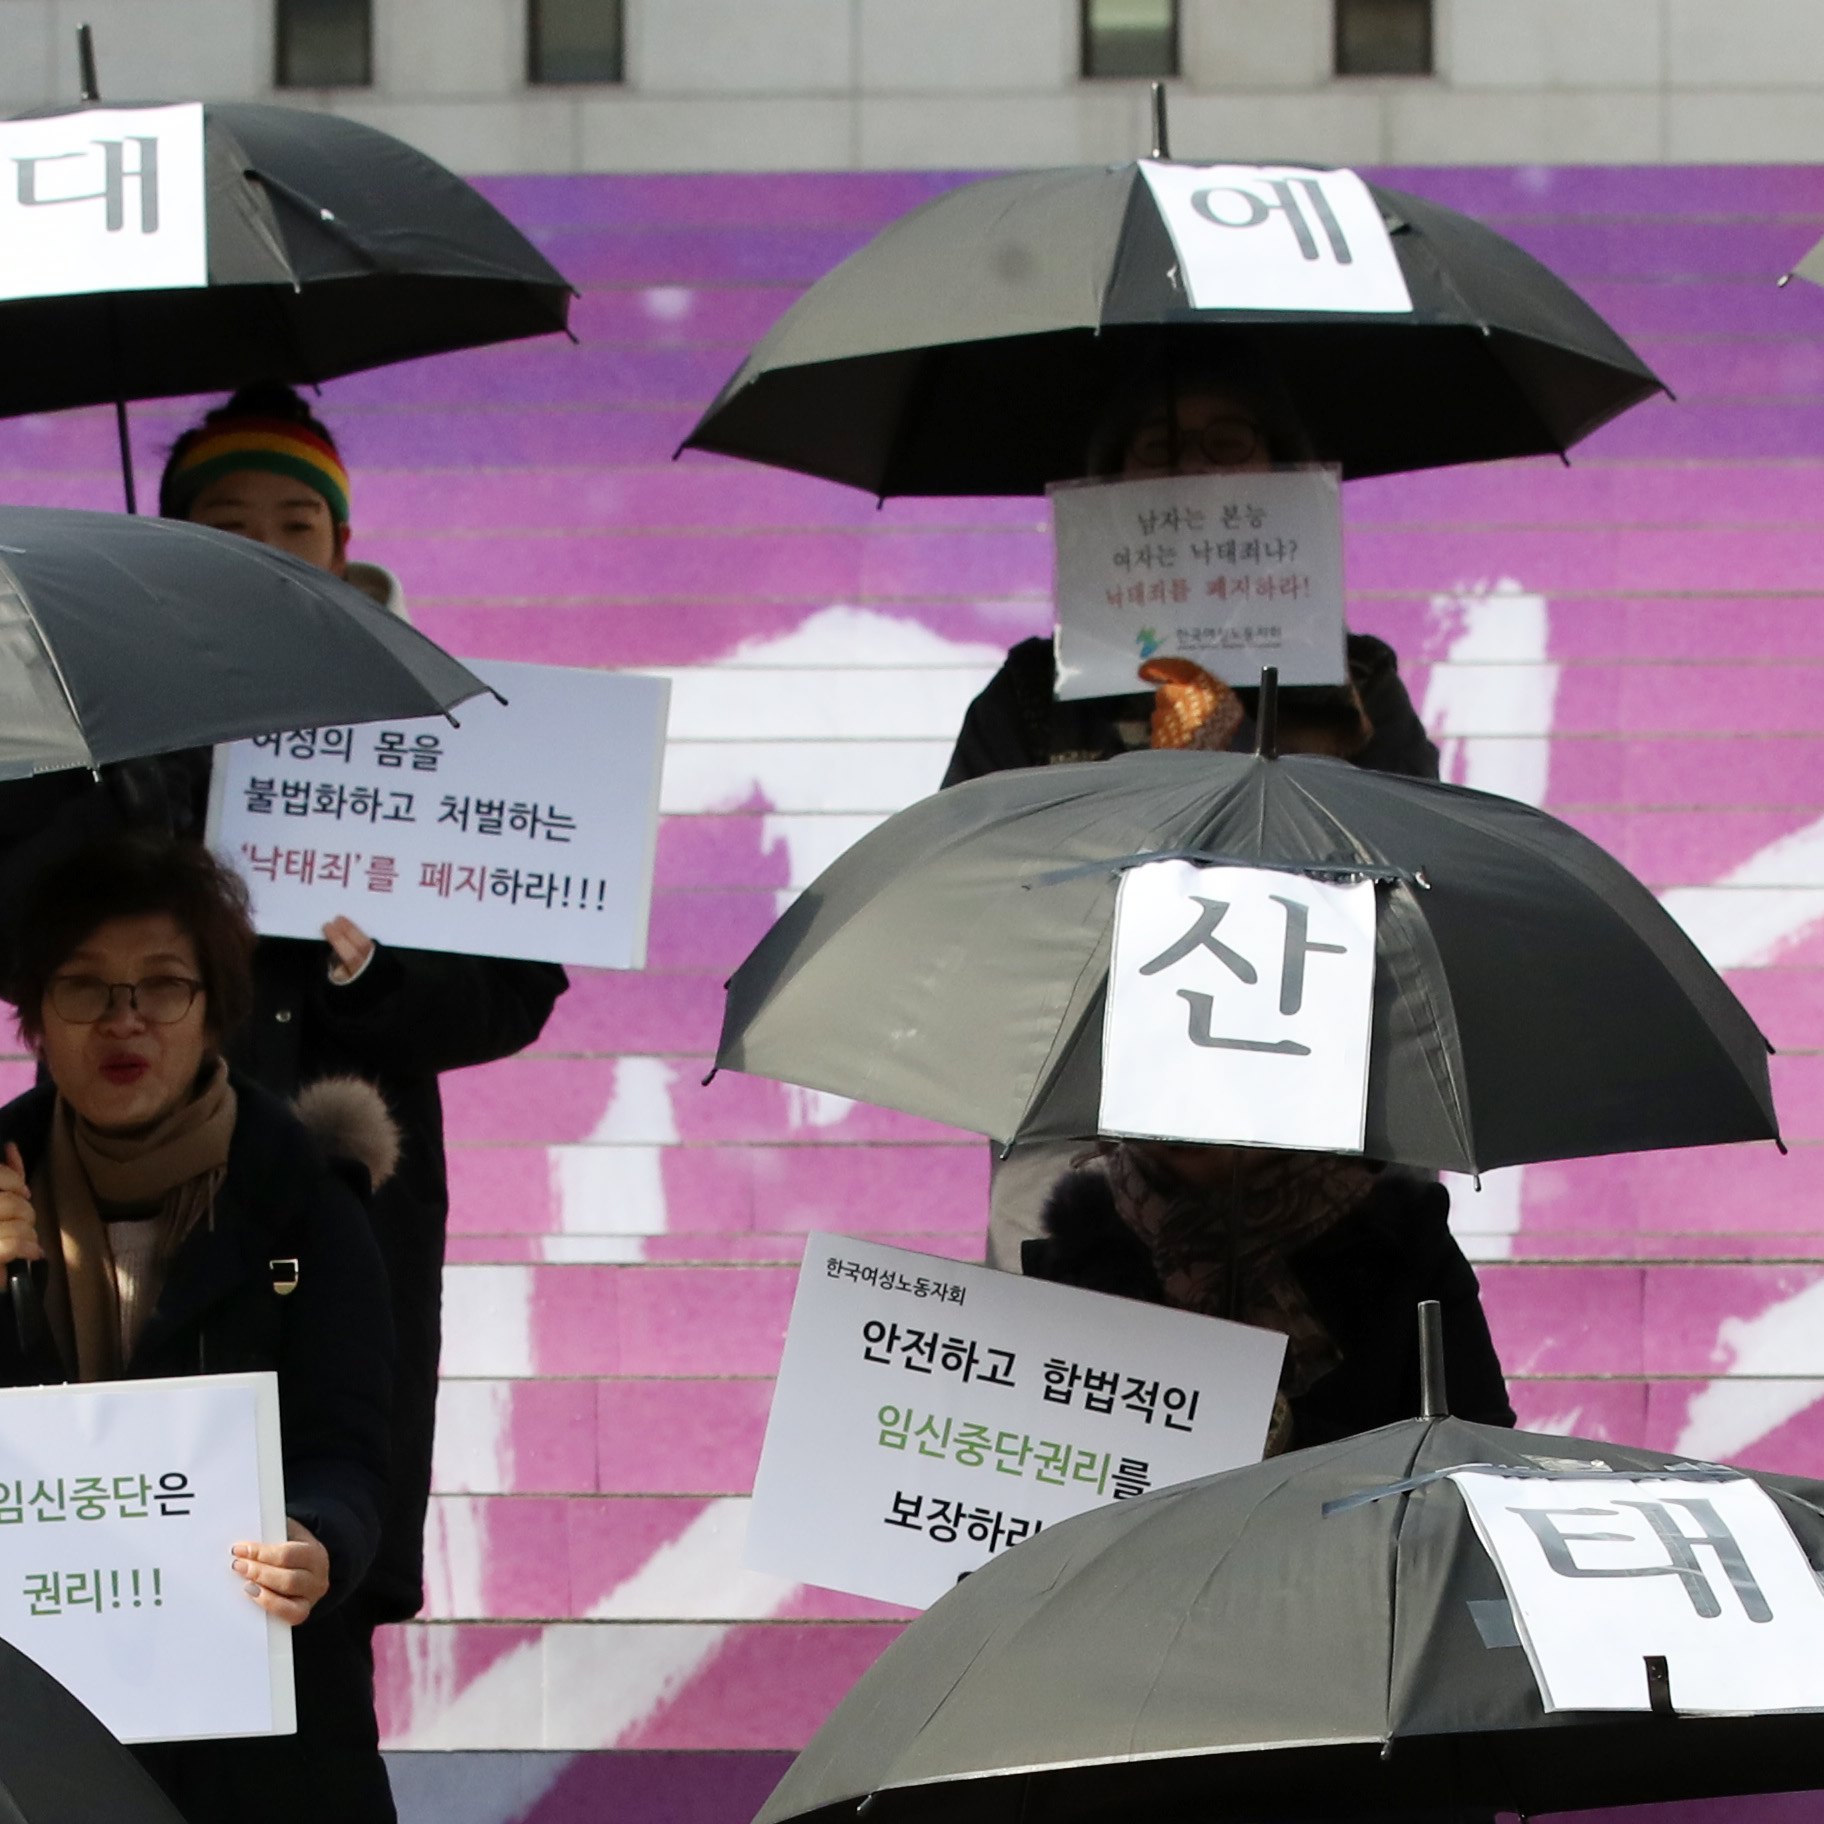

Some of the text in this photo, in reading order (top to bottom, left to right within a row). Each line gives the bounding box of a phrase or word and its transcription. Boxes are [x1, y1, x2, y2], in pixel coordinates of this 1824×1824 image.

[15, 136, 159, 234] 대
[1191, 177, 1353, 266] 에
[375, 731, 443, 771] 몸을
[244, 777, 576, 842] 불법화하고 처벌하는
[418, 862, 607, 911] 폐지하라!!!
[1139, 896, 1347, 1055] 산
[826, 1257, 967, 1306] 한국여성노동자회
[861, 1319, 1200, 1433] 안전하고 합법적인
[877, 1404, 1152, 1500] 임신중단권리를
[23, 1567, 163, 1617] 권리!!!
[1505, 1498, 1773, 1623] 태
